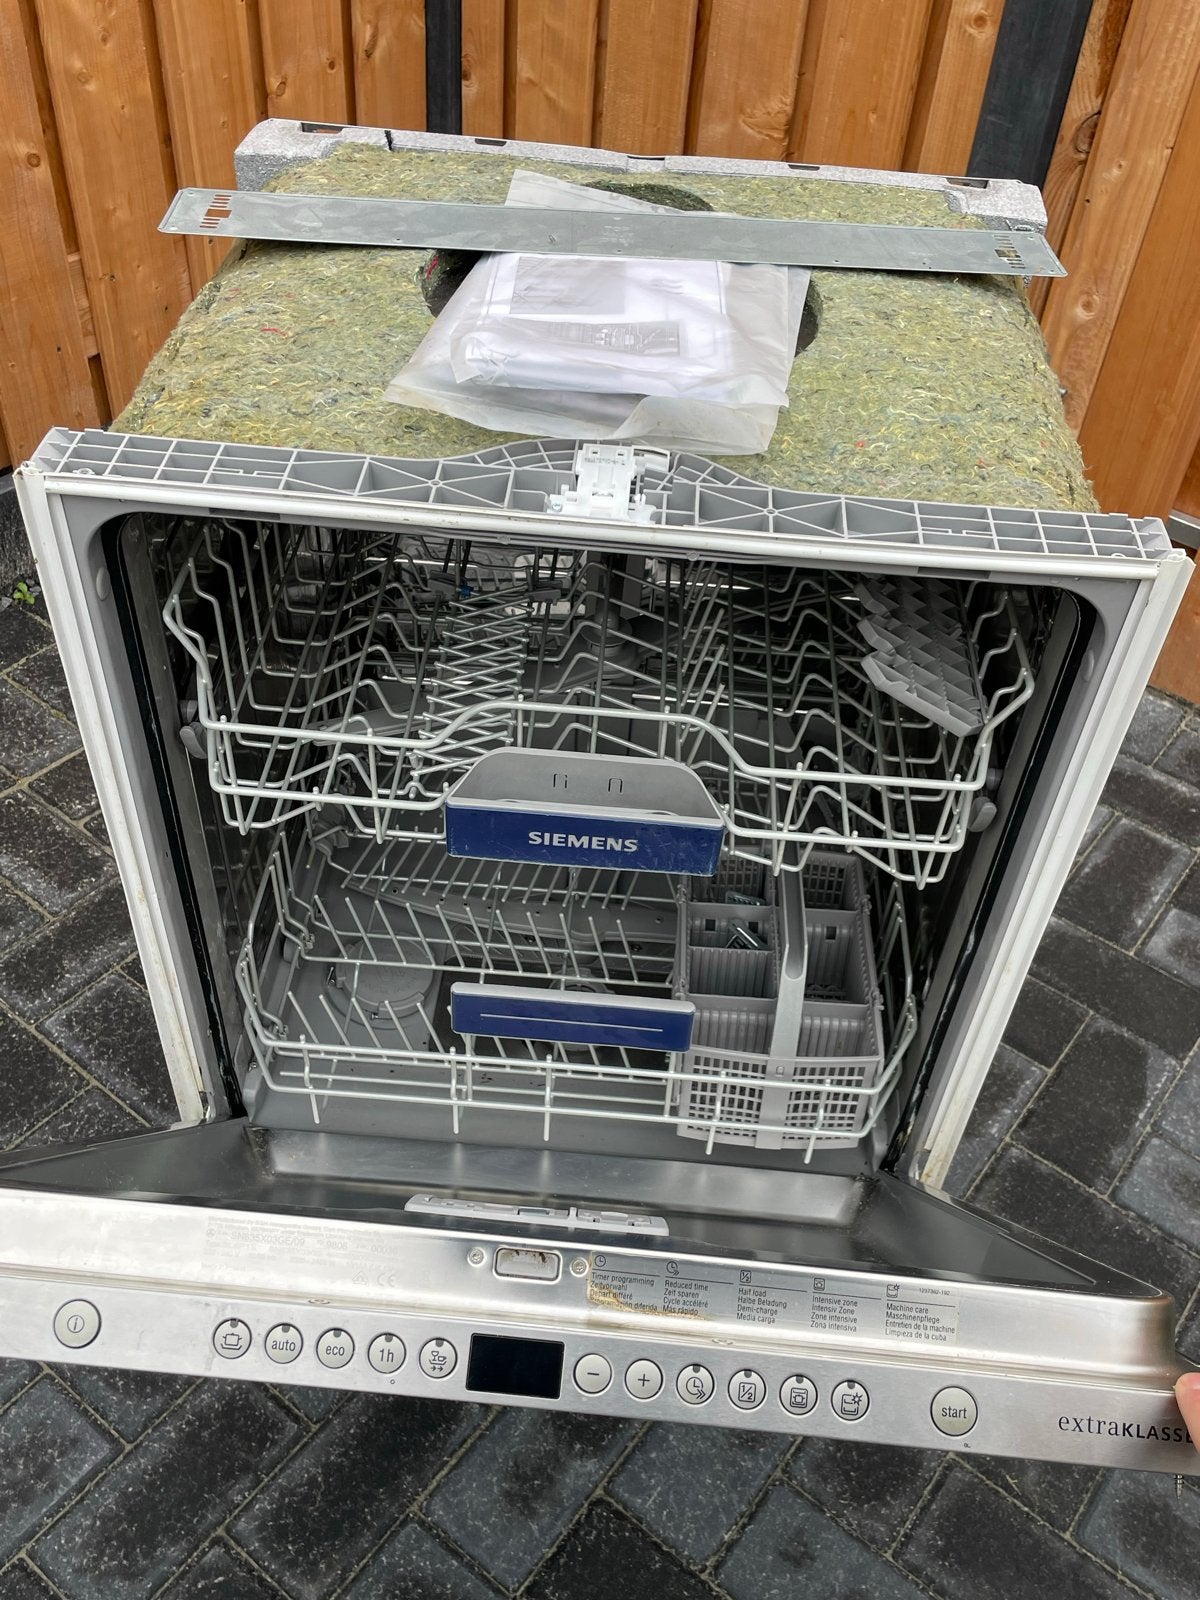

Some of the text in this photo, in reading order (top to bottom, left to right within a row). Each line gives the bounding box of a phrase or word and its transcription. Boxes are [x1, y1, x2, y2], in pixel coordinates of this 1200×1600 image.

[528, 832, 638, 852] SIEMENS
[591, 1272, 654, 1286] Timer programming
[664, 1280, 692, 1290] Reduced
[664, 1288, 700, 1298] Zeit sparen
[738, 1288, 767, 1298] Half load
[634, 1302, 658, 1311] diferida
[663, 1296, 708, 1308] Cycle accéléré
[738, 1296, 788, 1309] Halbe Beladung
[812, 1296, 842, 1305] Intensive
[662, 1304, 676, 1312] Más
[737, 1304, 778, 1316] Demi-charge
[812, 1304, 837, 1313] Intensiv
[886, 1302, 914, 1312] Machine
[736, 1312, 776, 1324] Media carga
[810, 1312, 858, 1324] Zone intensive
[886, 1312, 940, 1324] Maschinenpflege
[810, 1320, 857, 1332] Zona intensiva
[886, 1320, 912, 1330] Entretien
[930, 1325, 956, 1334] machine
[885, 1328, 912, 1338] Limpieza
[924, 1332, 930, 1340] la
[272, 1339, 296, 1353] auto
[326, 1344, 345, 1358] eco
[379, 1348, 394, 1363] 1h
[941, 1406, 968, 1419] start
